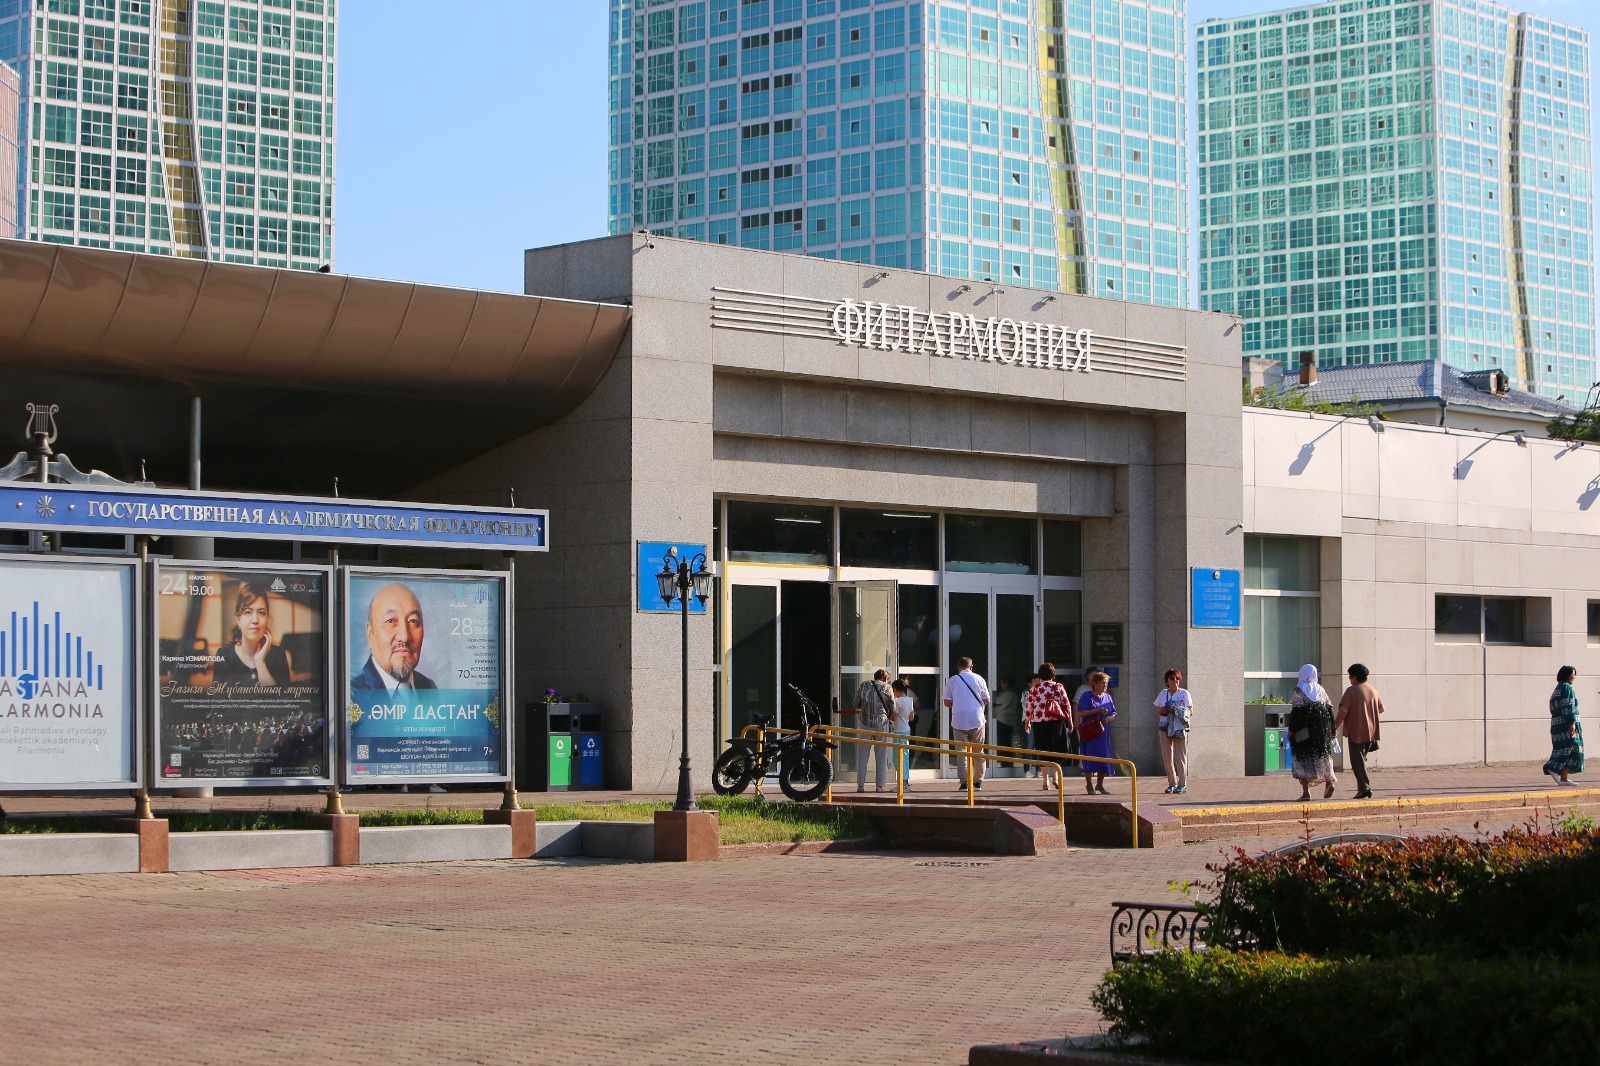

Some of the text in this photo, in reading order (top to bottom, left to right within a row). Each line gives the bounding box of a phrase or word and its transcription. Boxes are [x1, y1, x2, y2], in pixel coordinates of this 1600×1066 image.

[833, 298, 1094, 372] ФИЛАРМОНИЯ
[87, 500, 536, 537] ГОСУДАРСТВЕННАЯ АКАДЕМИЧЕСКАЯ ФИЛАРМОНИЯ
[161, 575, 187, 595] 24
[188, 585, 214, 596] 19.00
[450, 617, 473, 636] 28
[473, 626, 494, 635] 19:00
[458, 669, 471, 679] 70
[0, 680, 88, 698] ASTANA
[13, 726, 64, 735] Rahmadiev
[66, 726, 107, 737] atyndagy
[17, 746, 65, 755] Filarmonia
[483, 746, 494, 756] 7+
